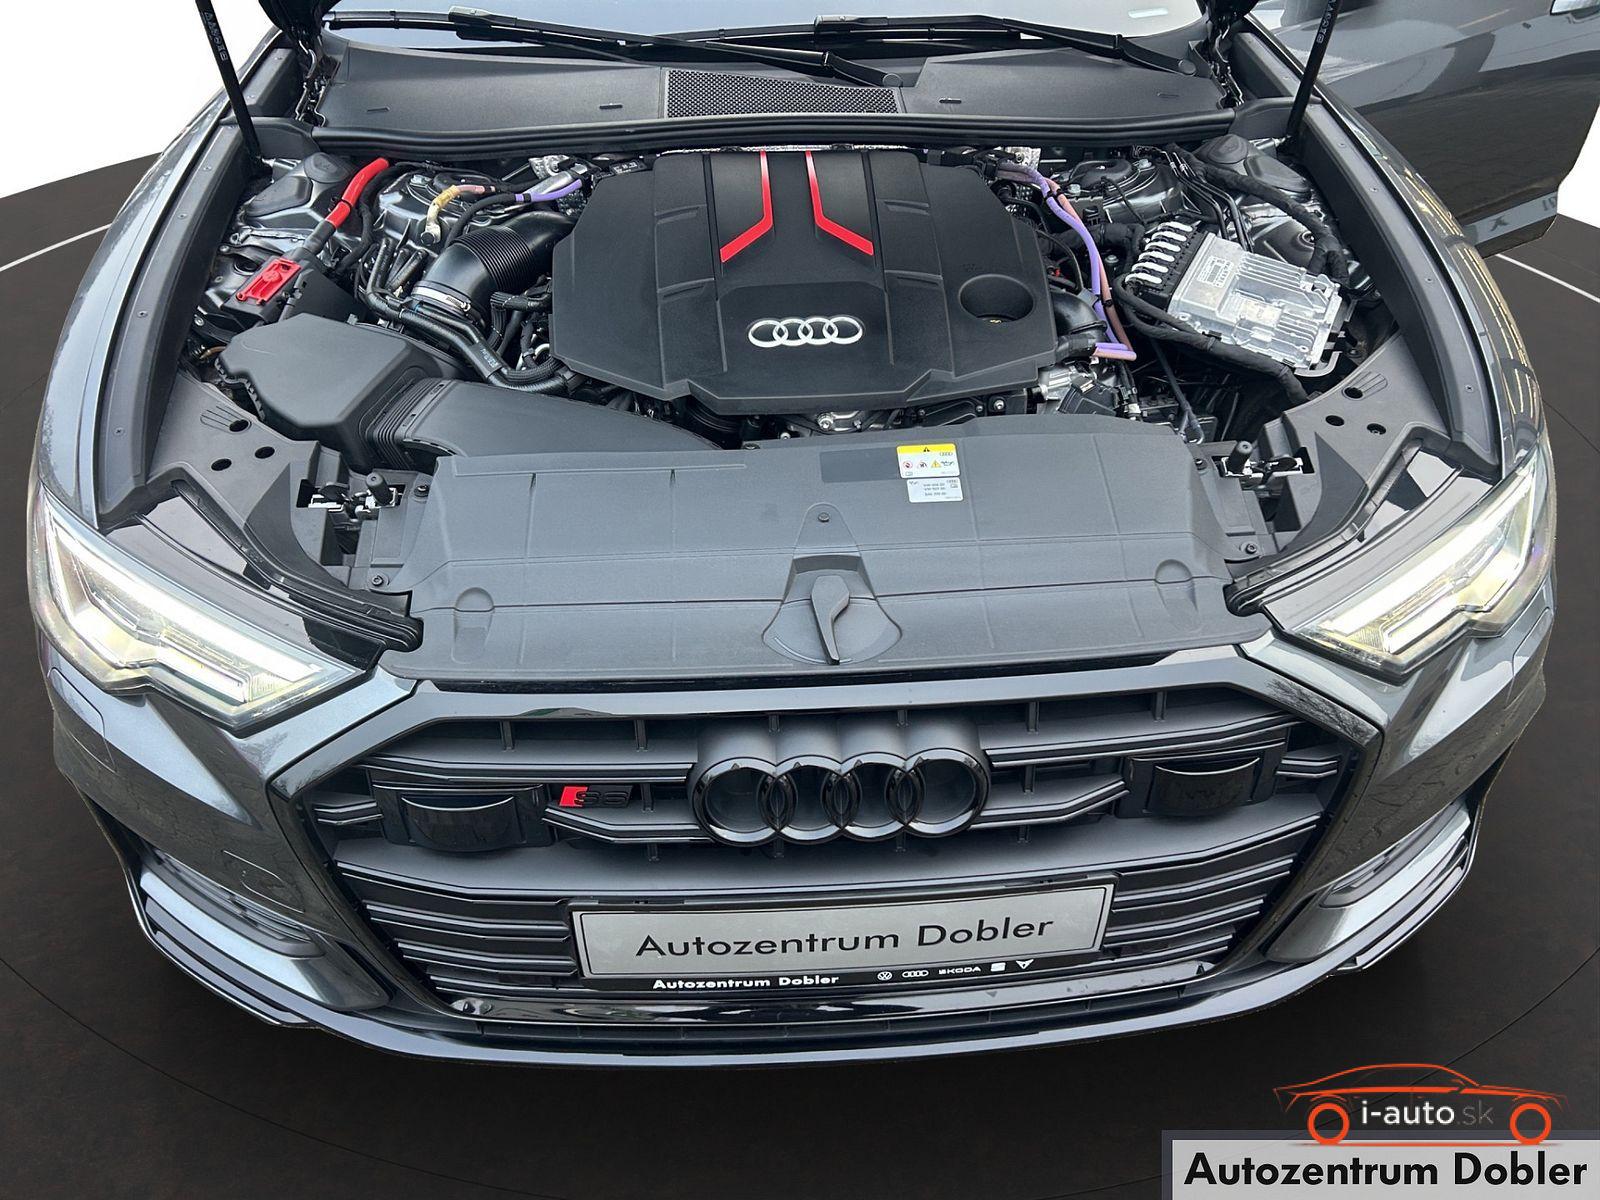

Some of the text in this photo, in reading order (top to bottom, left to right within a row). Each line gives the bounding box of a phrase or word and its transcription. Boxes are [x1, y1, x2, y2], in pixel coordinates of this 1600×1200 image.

[636, 916, 1053, 957] Autozentrum Dobler
[652, 975, 840, 989] Autozentrum Dobler
